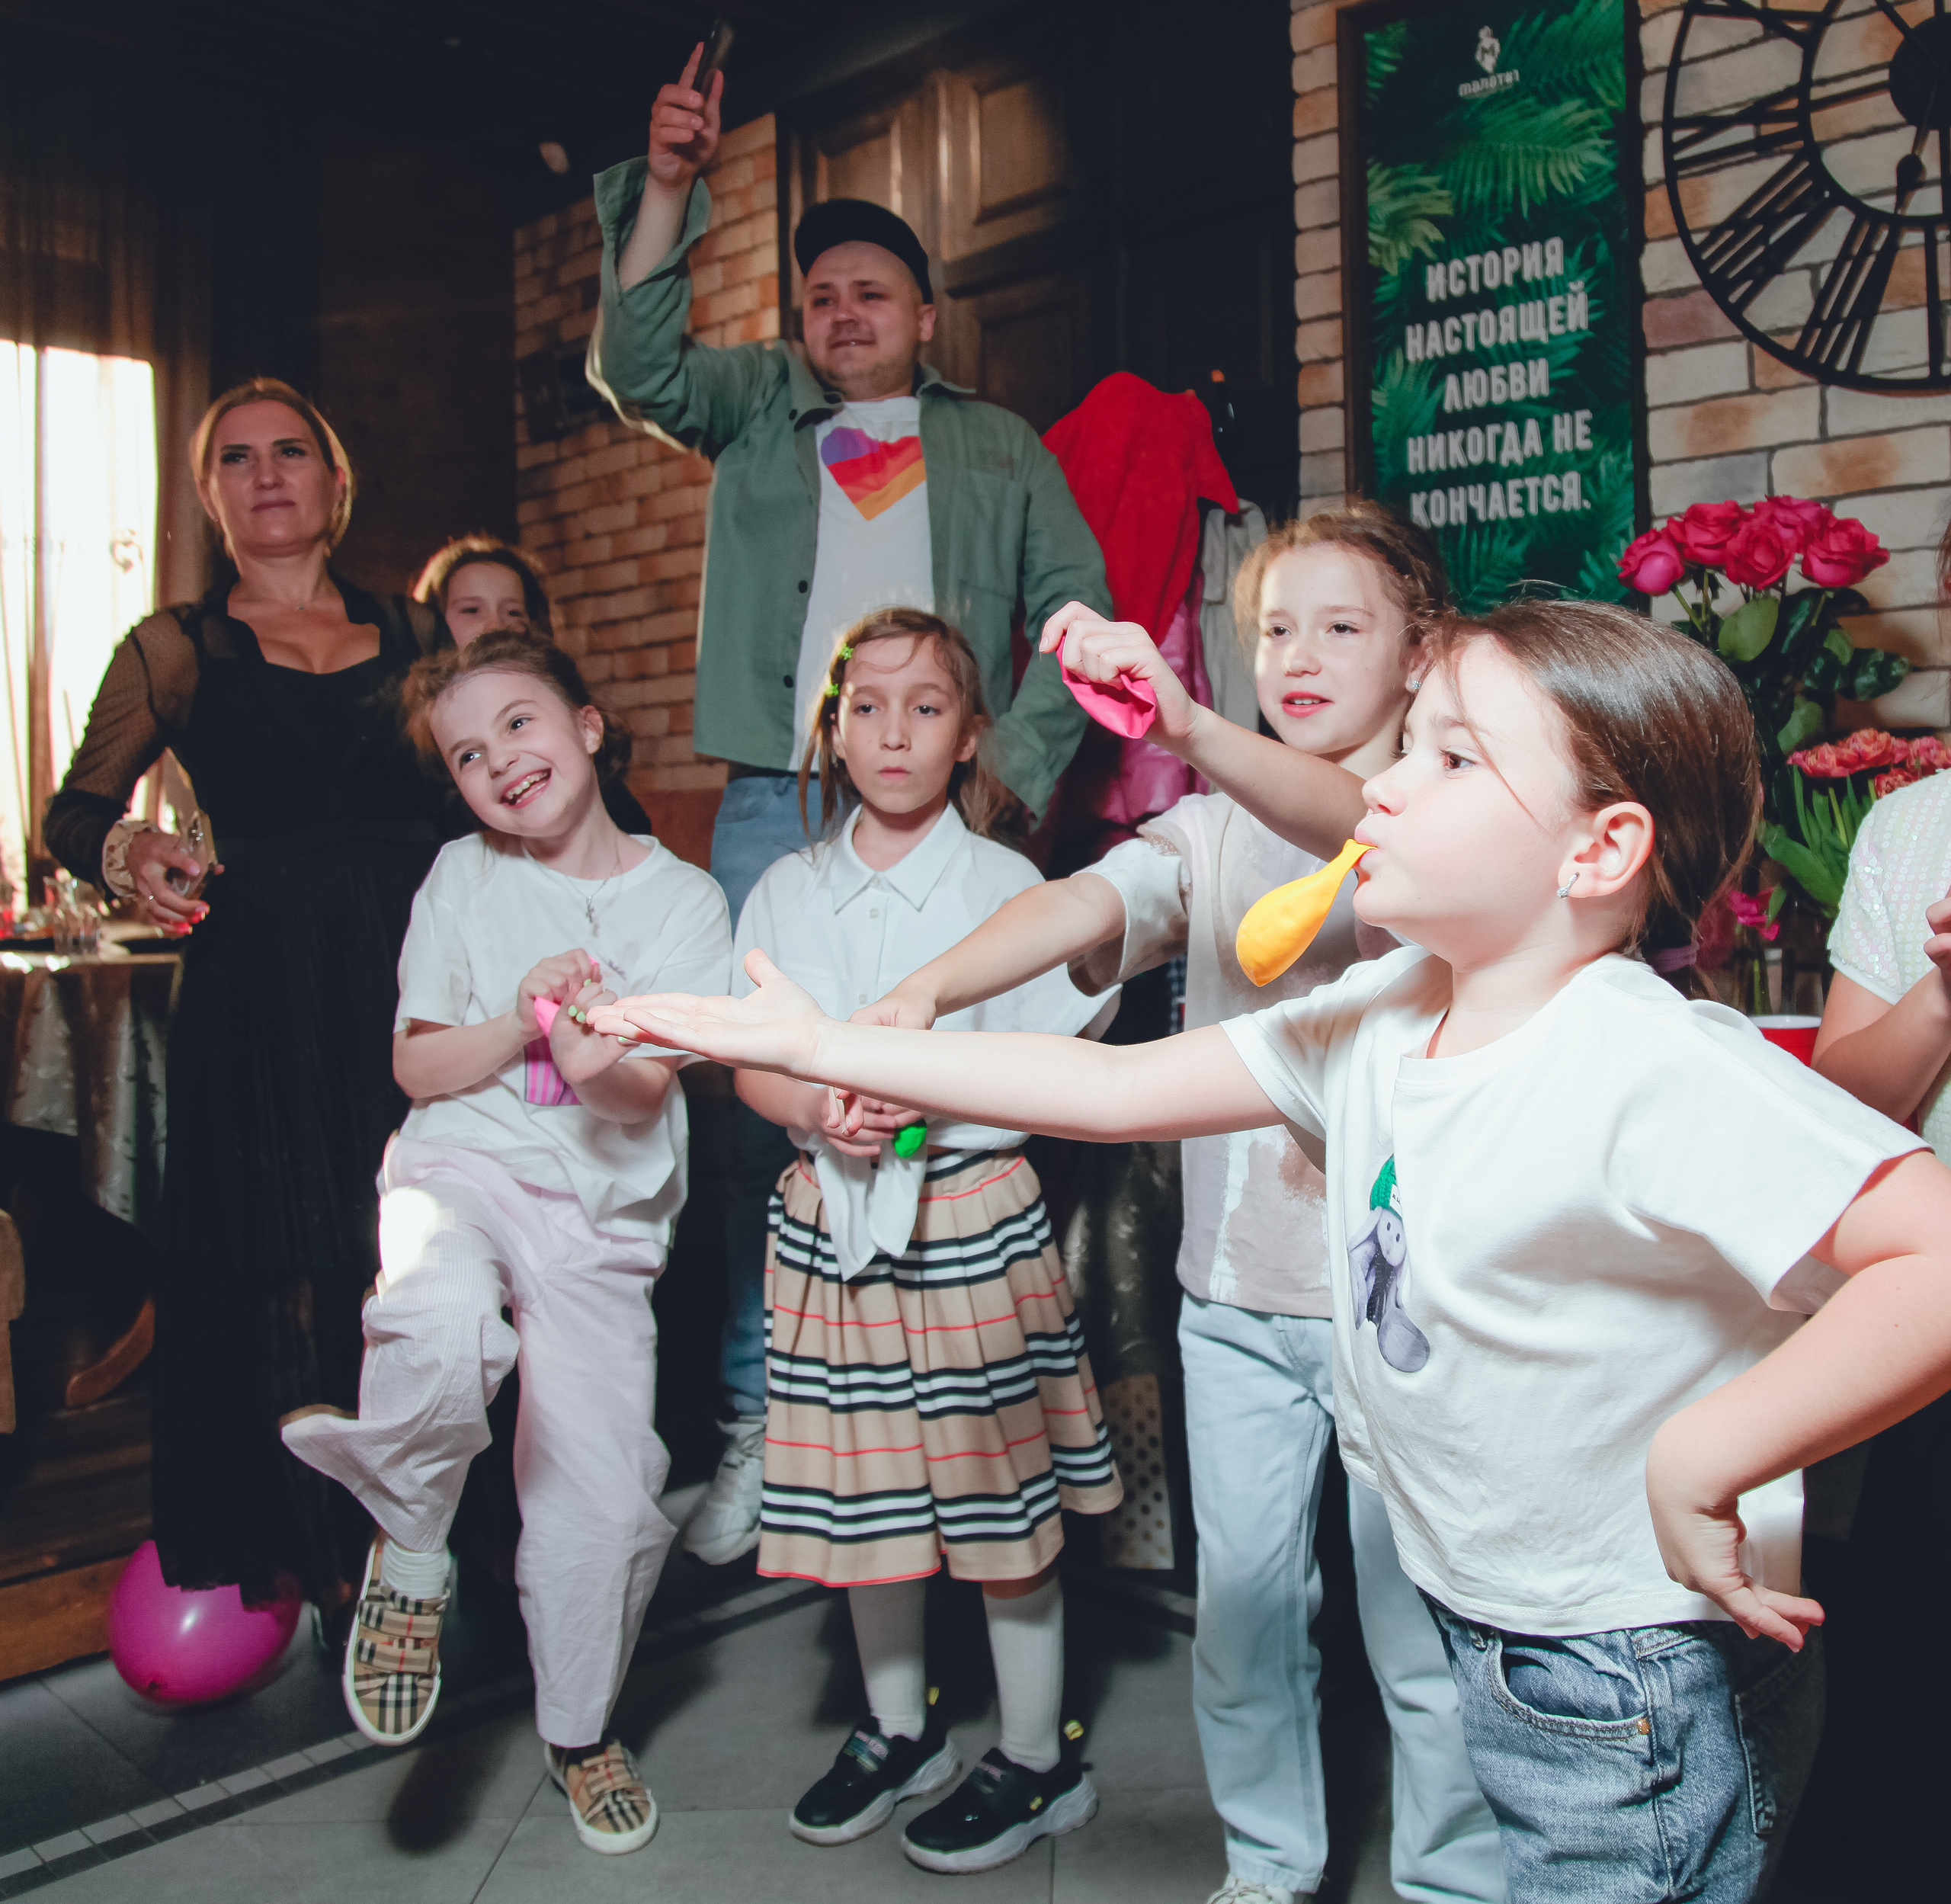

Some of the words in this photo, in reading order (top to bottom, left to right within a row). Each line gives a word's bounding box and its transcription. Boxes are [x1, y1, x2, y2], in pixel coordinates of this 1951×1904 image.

[1425, 236, 1564, 303] ИСТОРИЯ
[1405, 280, 1589, 364] НАСТОЯЩЕЙ
[1443, 357, 1550, 414] ЛЮБВИ
[1407, 418, 1543, 475] НИКОГДА
[1552, 409, 1594, 454] НЕ
[1410, 470, 1591, 530] КОНЧАЕТСЯ.
